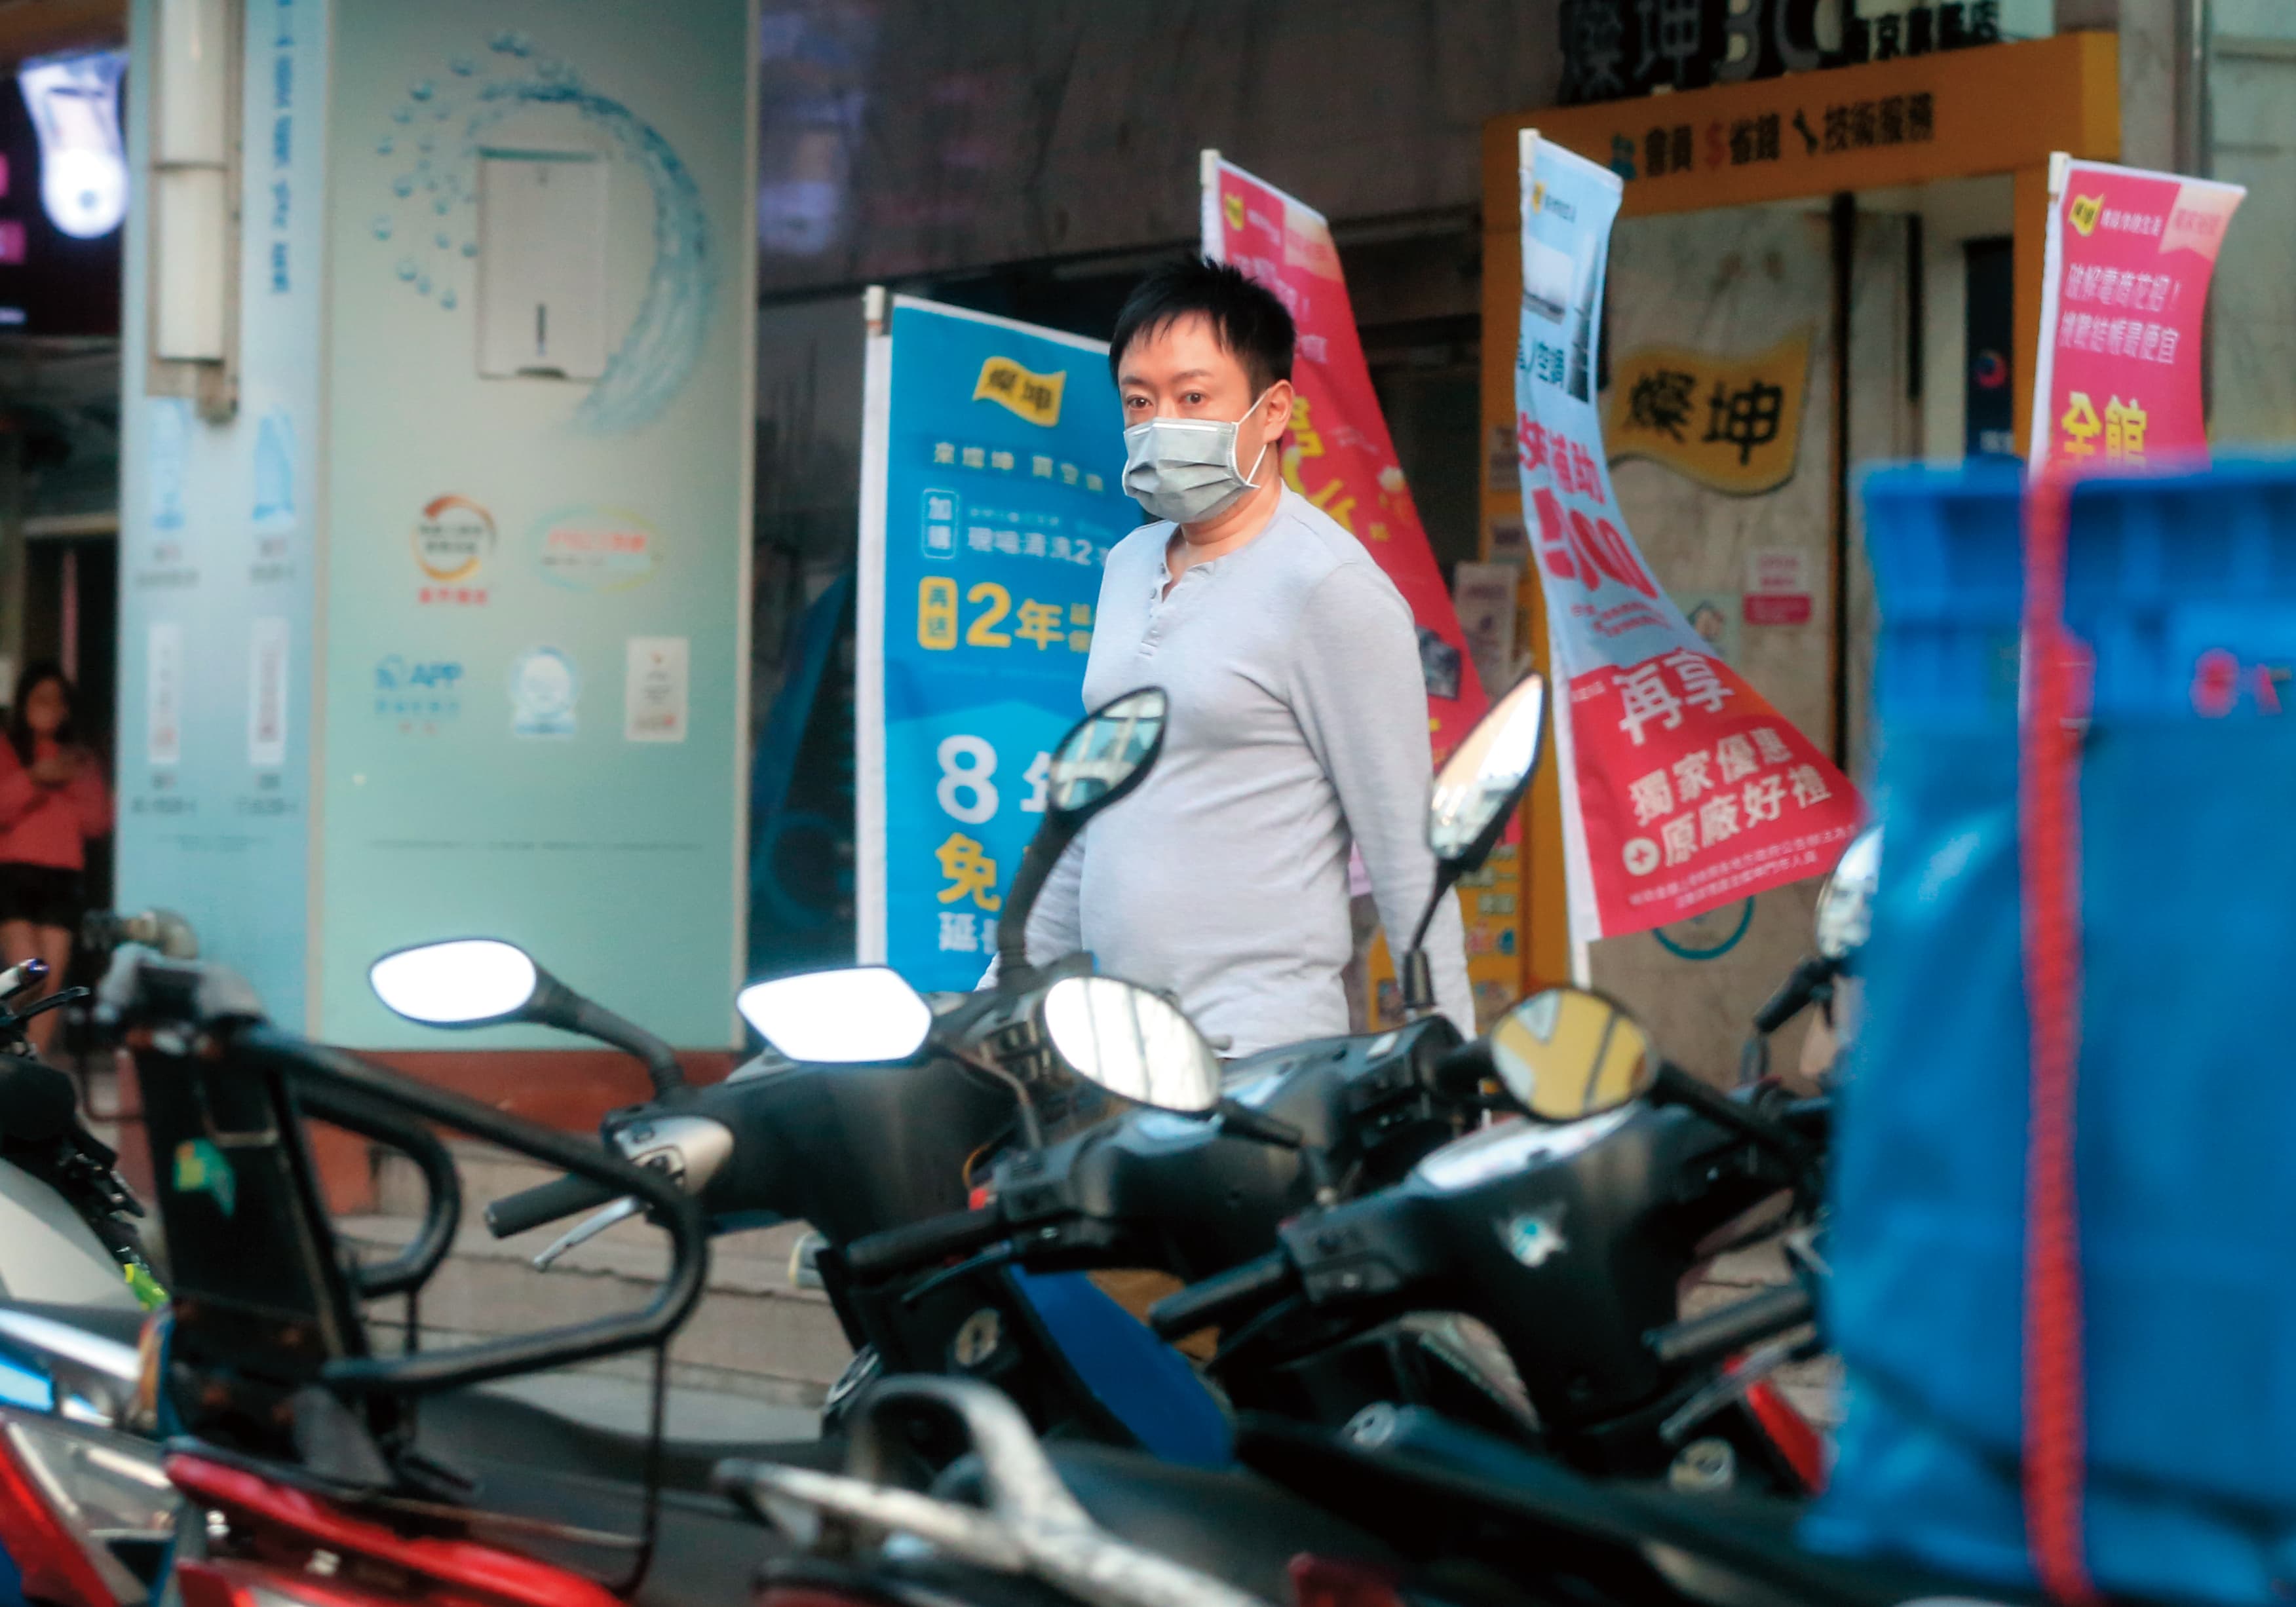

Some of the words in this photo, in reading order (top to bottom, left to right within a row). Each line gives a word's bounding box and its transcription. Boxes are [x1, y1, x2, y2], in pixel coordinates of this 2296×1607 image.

[1629, 369, 1782, 466] 燦坤
[966, 582, 1065, 651] 2年
[1611, 650, 1734, 746] 再享
[1628, 727, 1794, 827] 獨家優惠
[1660, 763, 1833, 868] 原廠好禮
[935, 832, 1031, 911] 免
